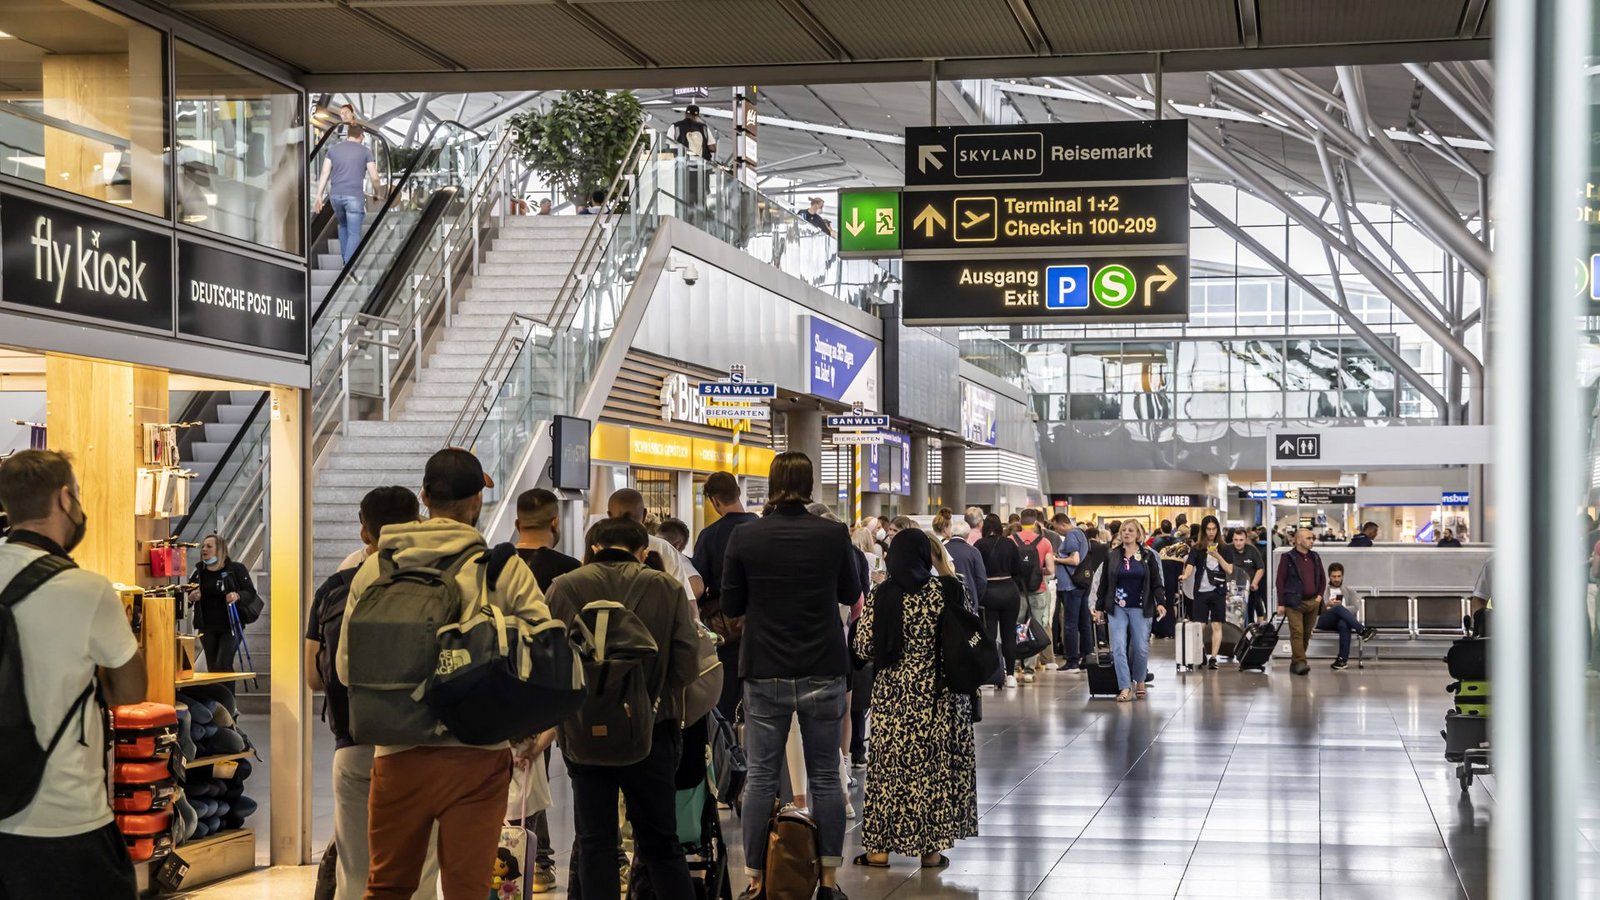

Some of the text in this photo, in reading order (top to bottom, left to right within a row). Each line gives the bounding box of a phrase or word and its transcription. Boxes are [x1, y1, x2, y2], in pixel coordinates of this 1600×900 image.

[959, 143, 1153, 162] SKYLAND Reisemarkt
[1004, 196, 1119, 214] Terminal 1+2
[1004, 217, 1157, 236] Check-in 100-209
[31, 215, 147, 303] fly kiosk
[959, 267, 1039, 287] Ausgang
[1101, 270, 1129, 303] S
[1004, 290, 1039, 306] Exit
[1058, 276, 1077, 304] P
[191, 280, 296, 320] DEUTSCHE POST DHL
[704, 385, 769, 395] SANWALD
[706, 409, 765, 417] BIERGARTEN
[1138, 495, 1190, 506] HALLHUBER
